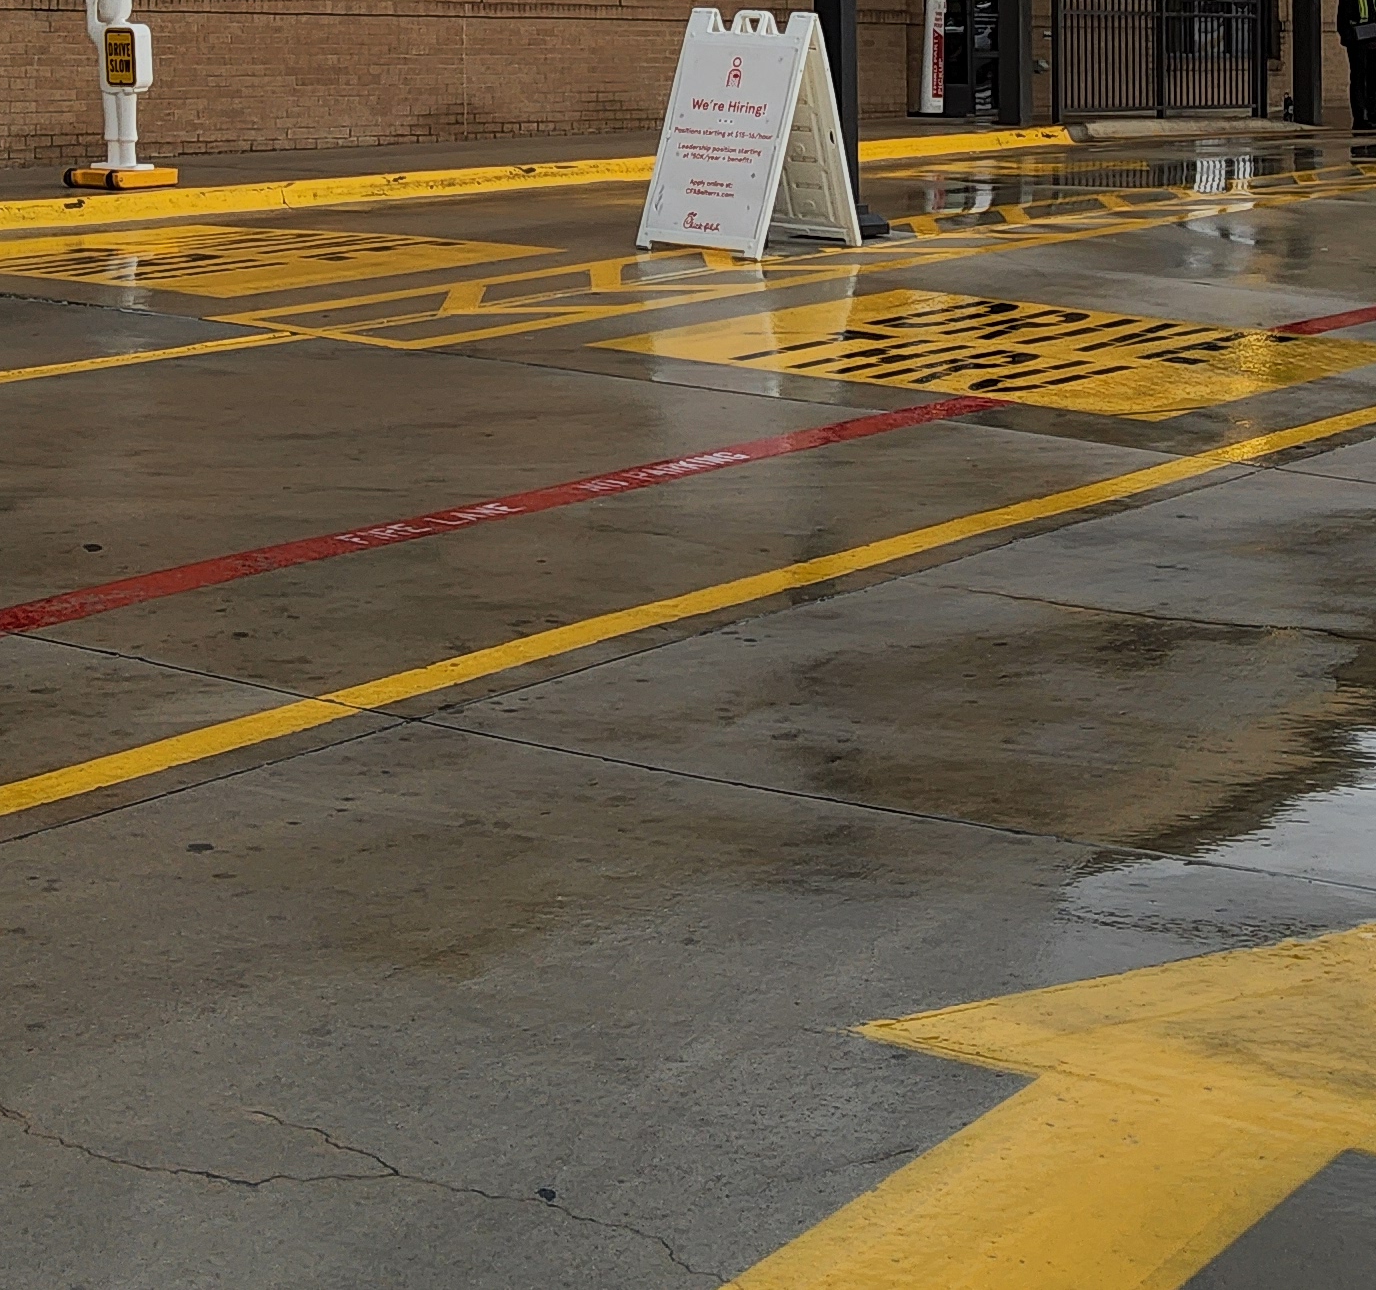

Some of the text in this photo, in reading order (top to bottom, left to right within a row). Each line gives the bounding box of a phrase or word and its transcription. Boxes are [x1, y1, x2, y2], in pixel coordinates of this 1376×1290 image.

[108, 42, 131, 58] DRIVE
[109, 58, 131, 73] SLOW
[692, 97, 768, 118] We're Hiring!
[674, 126, 702, 135] Positions
[702, 129, 726, 138] starting
[678, 142, 762, 157] Leadership position starting
[727, 156, 753, 164] benefits
[689, 179, 705, 188] Apply
[706, 180, 725, 188] online
[862, 300, 1299, 366] DRIVE
[728, 329, 1136, 393] THRU
[335, 522, 431, 546] FIRE
[424, 501, 526, 526] LANE
[630, 450, 751, 482] PARKING
